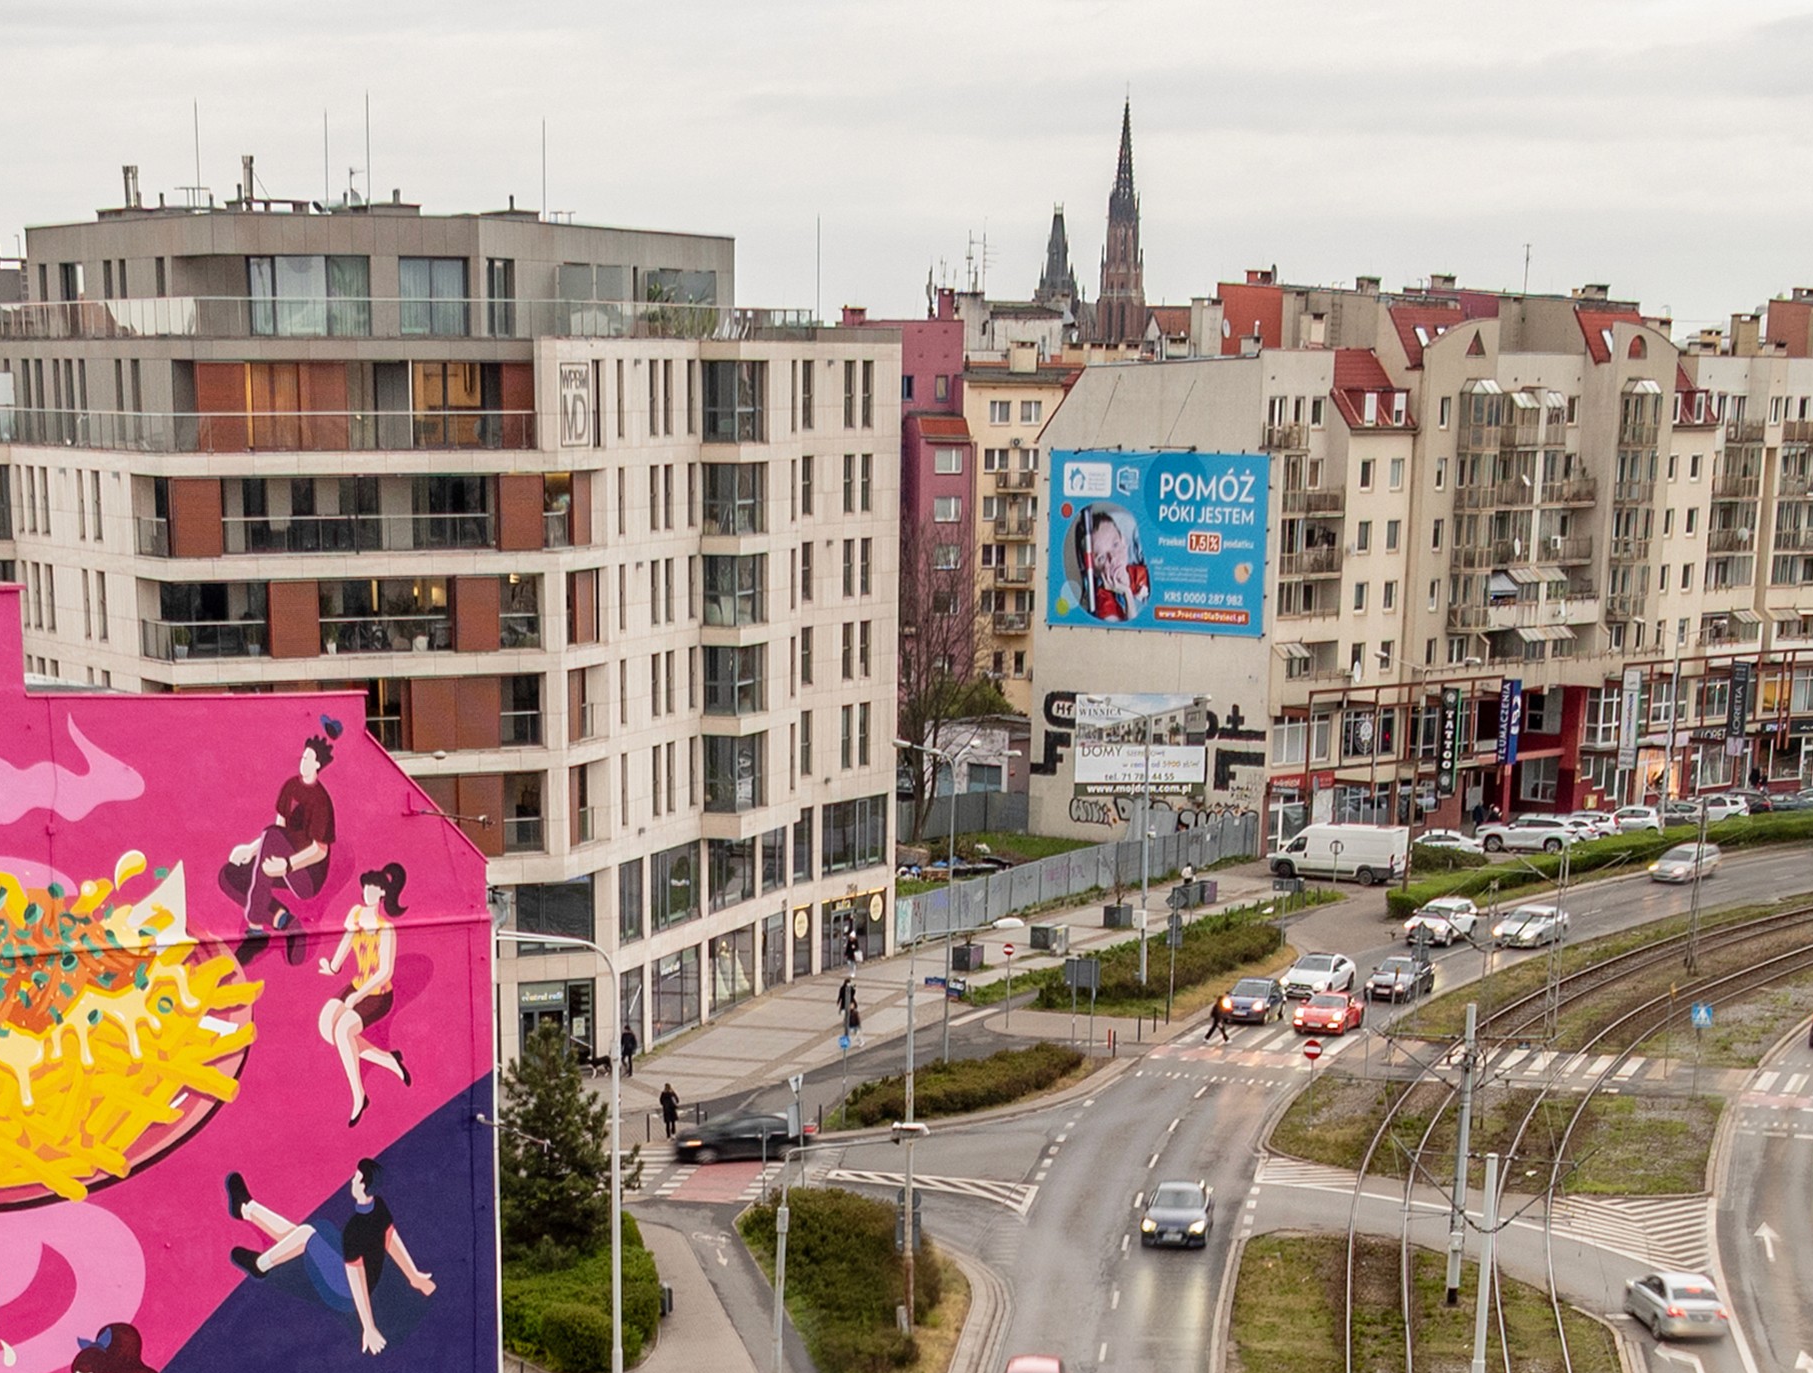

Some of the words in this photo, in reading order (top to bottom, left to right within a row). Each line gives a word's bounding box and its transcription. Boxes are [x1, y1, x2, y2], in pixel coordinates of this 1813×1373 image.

[1159, 467, 1255, 503] POMÓŻ
[1159, 501, 1194, 522] PÓKI
[1197, 506, 1255, 526] JESTEM
[1081, 746, 1123, 757] DOMY
[1442, 710, 1454, 770] TATTOO
